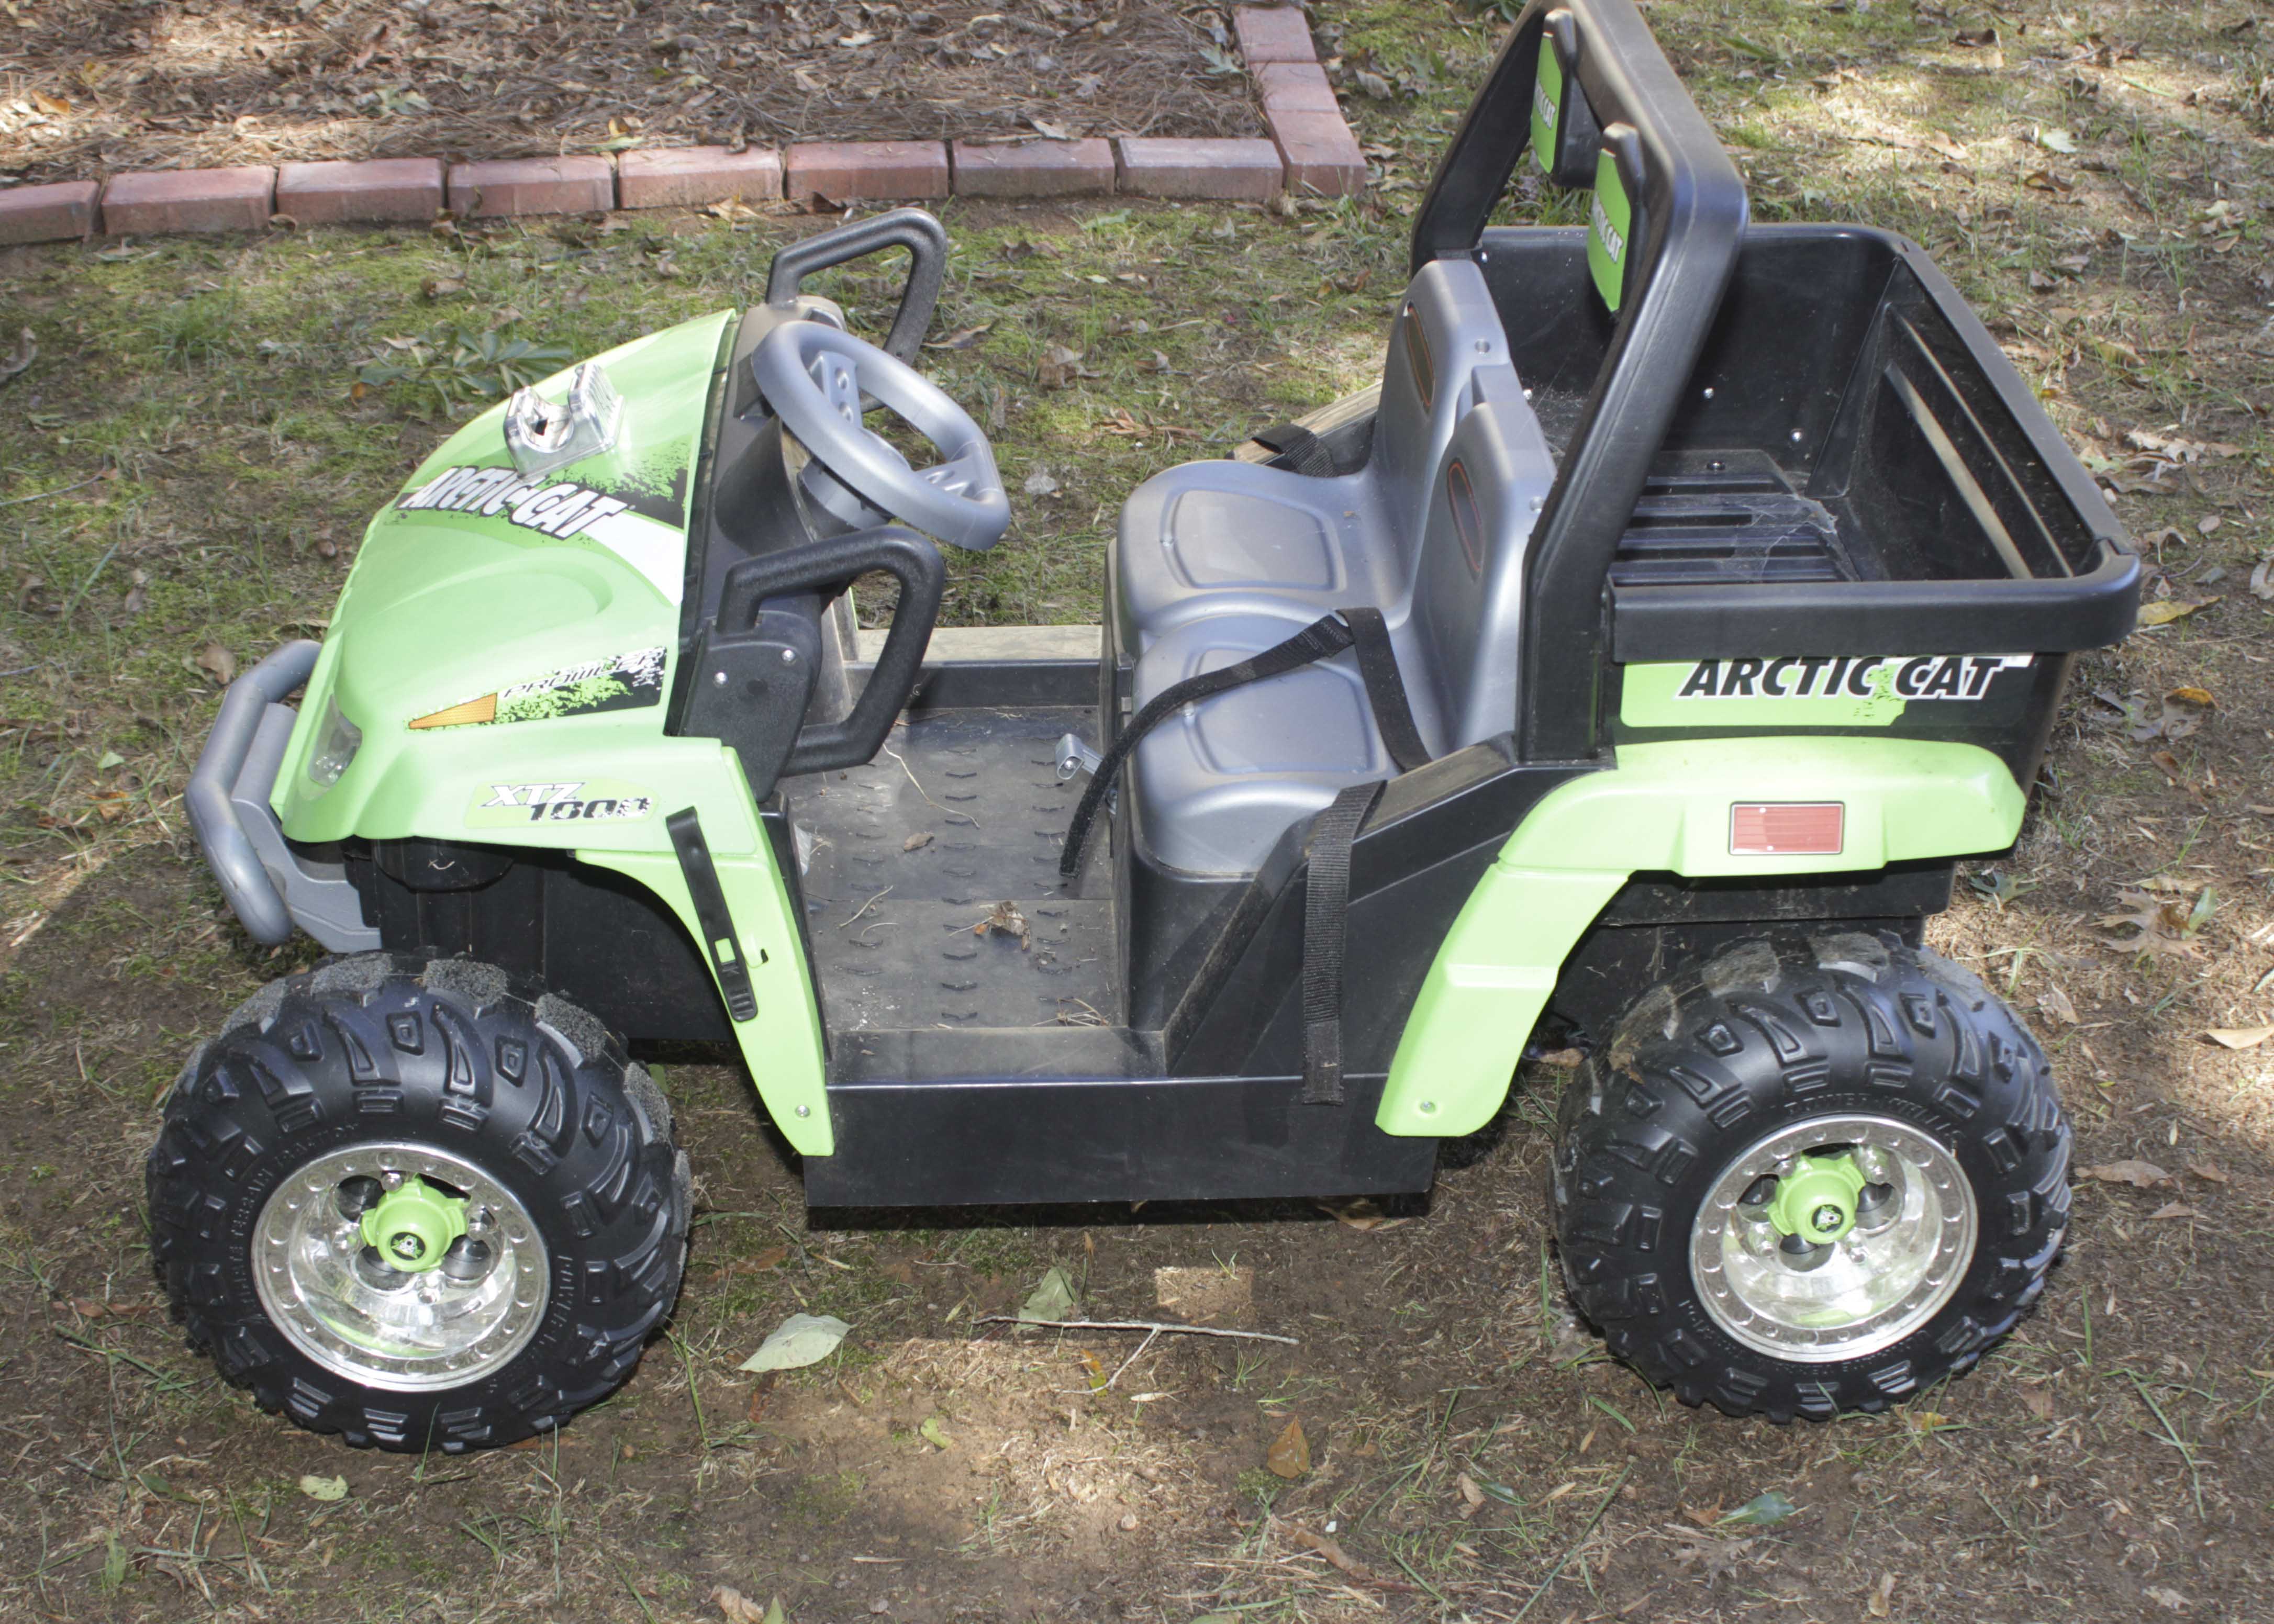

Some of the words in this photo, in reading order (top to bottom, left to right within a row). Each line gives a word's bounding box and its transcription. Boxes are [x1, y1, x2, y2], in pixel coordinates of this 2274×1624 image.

[397, 465, 547, 517] ARCTIC
[508, 483, 628, 540] CAT
[502, 647, 665, 698] PROWLER
[1674, 656, 1885, 698] ARCTIC
[1893, 656, 2004, 700] CAT
[481, 782, 586, 807] XTZ
[529, 797, 651, 821] 1000
